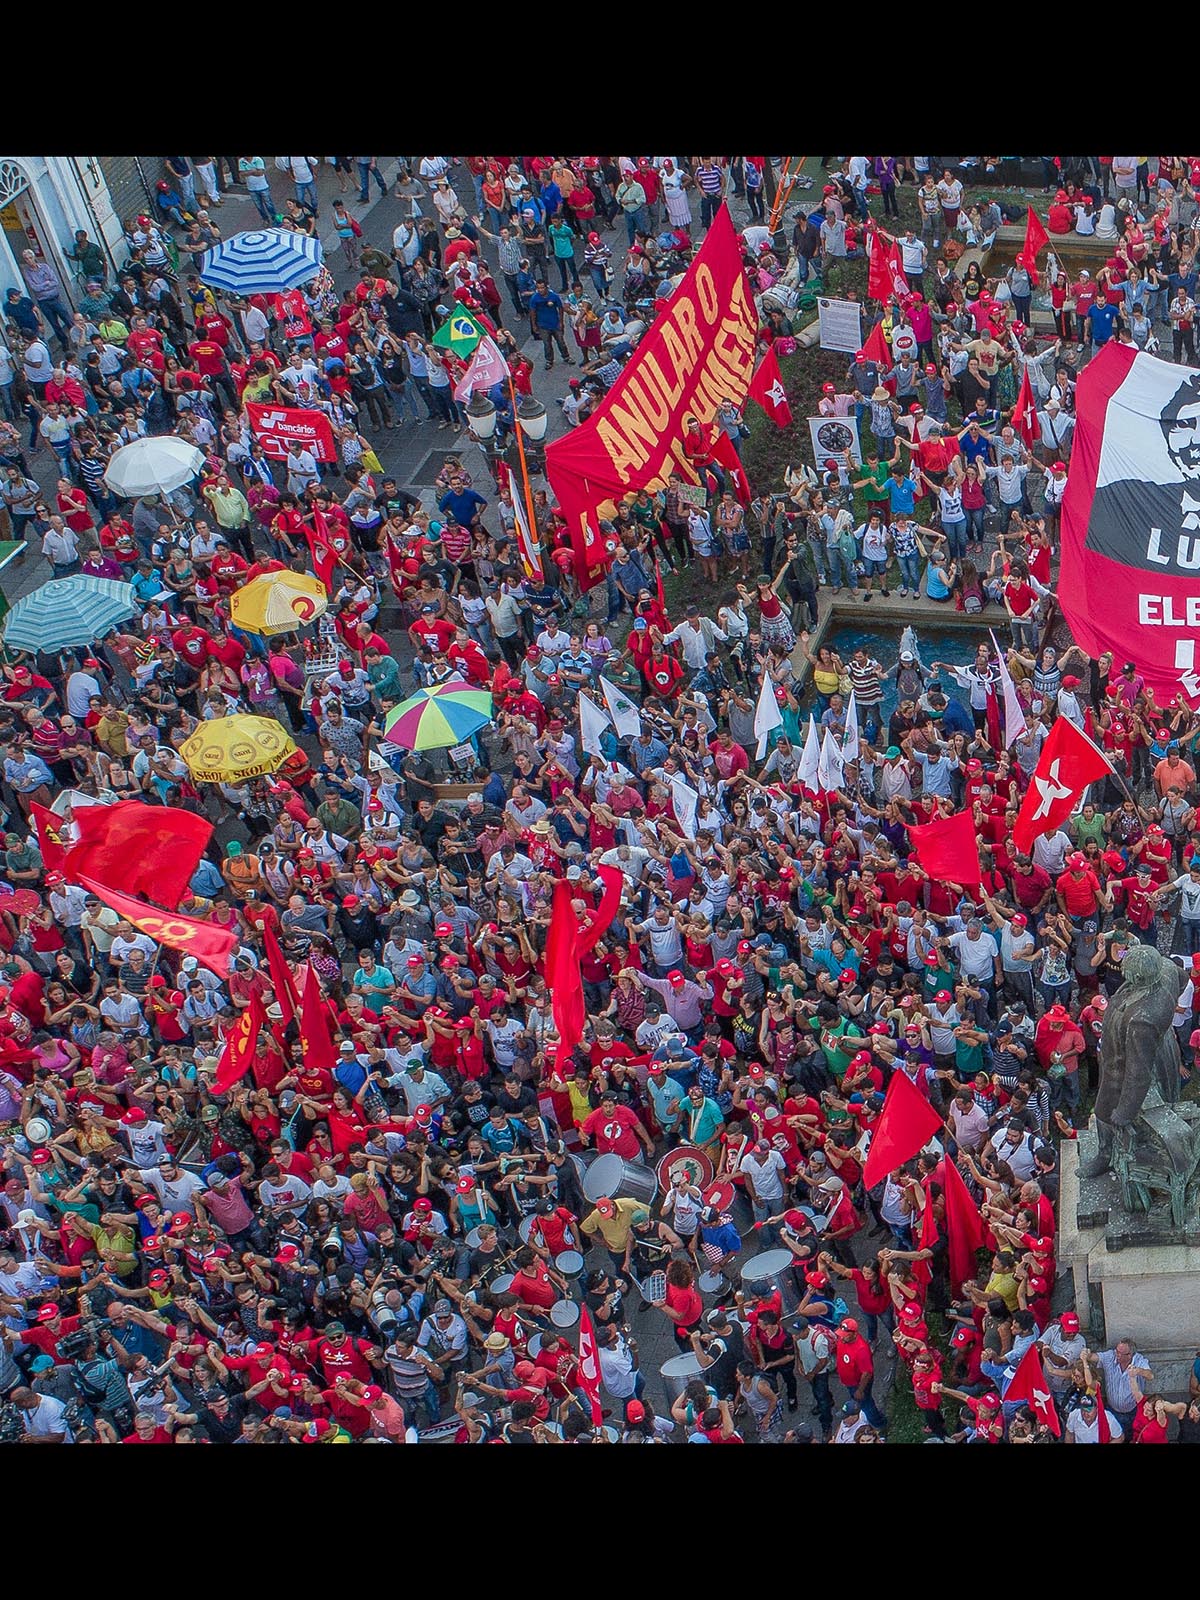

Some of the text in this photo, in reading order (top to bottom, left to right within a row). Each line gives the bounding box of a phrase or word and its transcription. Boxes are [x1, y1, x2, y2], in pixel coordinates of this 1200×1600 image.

[326, 336, 343, 348] CUT
[596, 296, 705, 485] ANULAR
[695, 262, 720, 326] O
[277, 421, 317, 434] bancários
[196, 770, 227, 782] SKOL
[233, 764, 266, 780] SKOL
